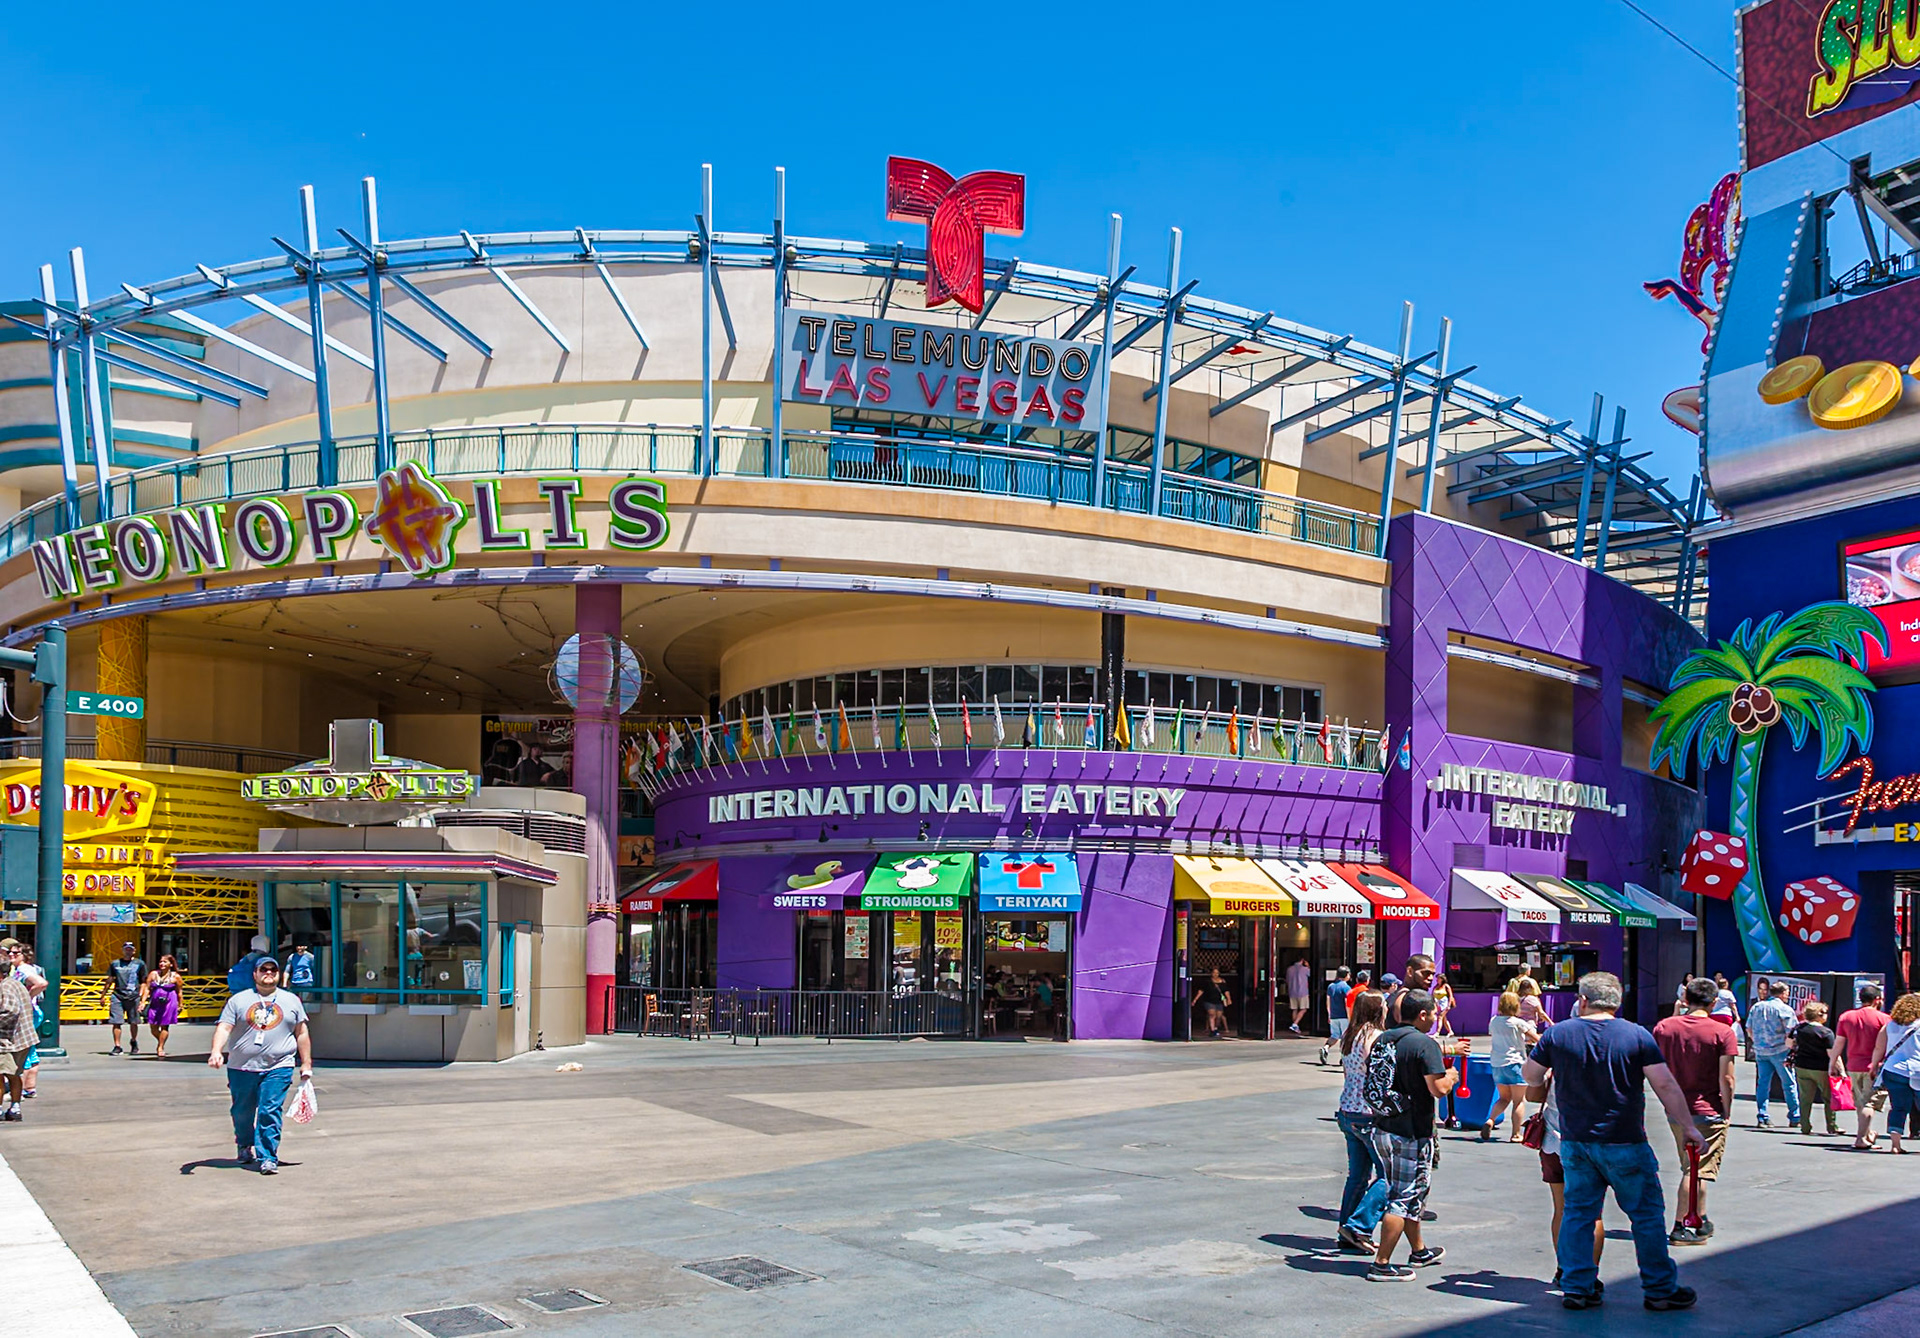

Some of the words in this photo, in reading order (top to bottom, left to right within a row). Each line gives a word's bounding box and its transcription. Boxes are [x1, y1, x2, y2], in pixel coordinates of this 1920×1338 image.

[800, 316, 1090, 382] TELEMUNDO
[800, 358, 892, 403] LAS
[918, 371, 1087, 423] VEGAS
[78, 696, 91, 709] E
[97, 698, 138, 714] 400
[1440, 762, 1612, 812] INTERNATIONAL
[708, 783, 1006, 824] INTERNATIONAL
[1021, 783, 1186, 818] EATERY
[1492, 800, 1577, 836] EATERY
[96, 847, 154, 862] DINER
[84, 873, 136, 892] OPEN
[629, 900, 653, 911] RAMEN
[773, 896, 827, 908] SWEETS
[864, 895, 954, 908] STROMBOLIS
[995, 896, 1068, 909] TERIYAKI
[1224, 900, 1281, 913] BURGERS
[1306, 902, 1363, 915] BURRITOS
[1382, 905, 1431, 918] NOODLES
[1521, 910, 1547, 922] TACOS
[1570, 912, 1587, 924] RICE
[1588, 912, 1612, 925] BOWLS
[1625, 915, 1653, 927] PIZZERIA
[936, 927, 961, 938] 10%
[936, 937, 961, 945] OFF
